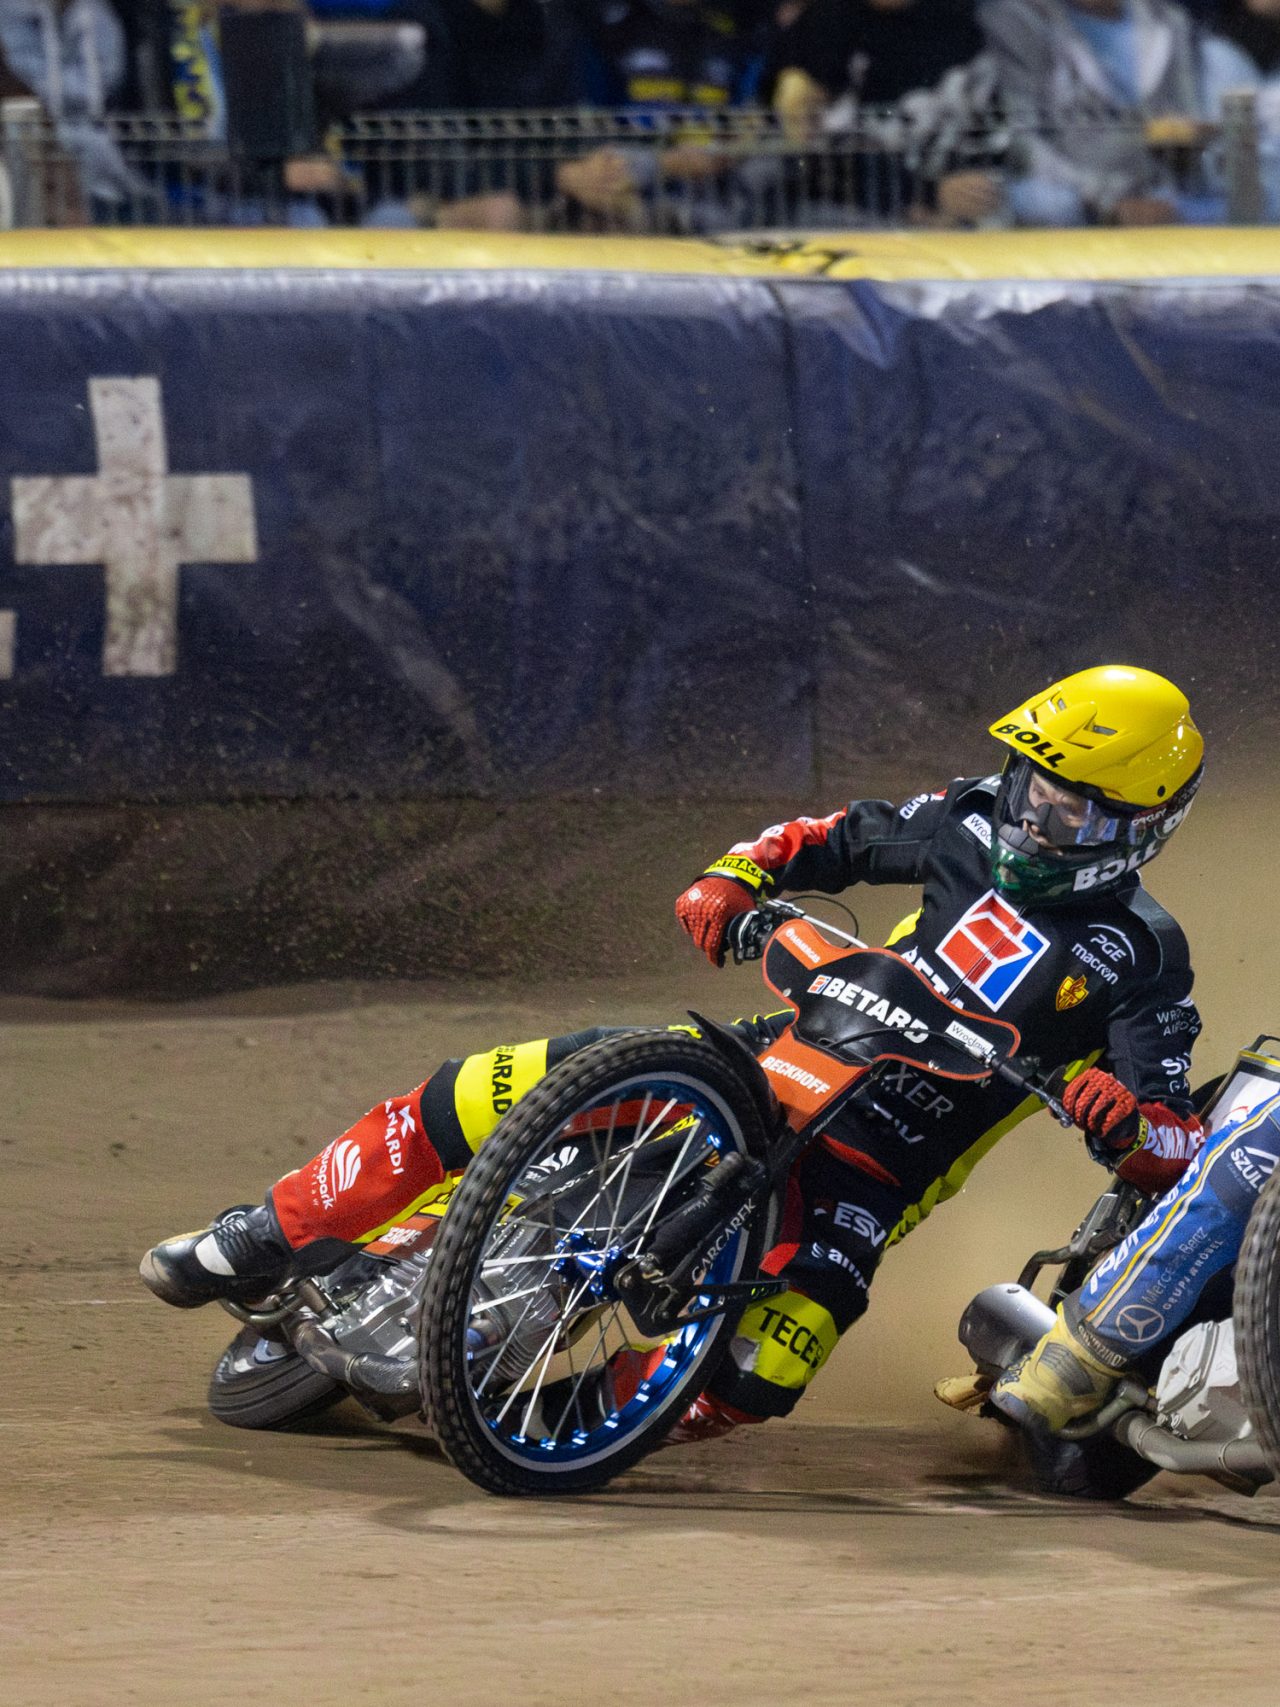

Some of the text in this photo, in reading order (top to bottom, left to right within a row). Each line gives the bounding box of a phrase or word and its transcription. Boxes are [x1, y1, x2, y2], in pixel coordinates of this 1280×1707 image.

[995, 723, 1067, 768] BOLL
[1071, 942, 1120, 986] macron
[1089, 933, 1127, 962] PGE
[823, 977, 930, 1045] BETARD
[760, 1055, 831, 1097] BECKHOFF
